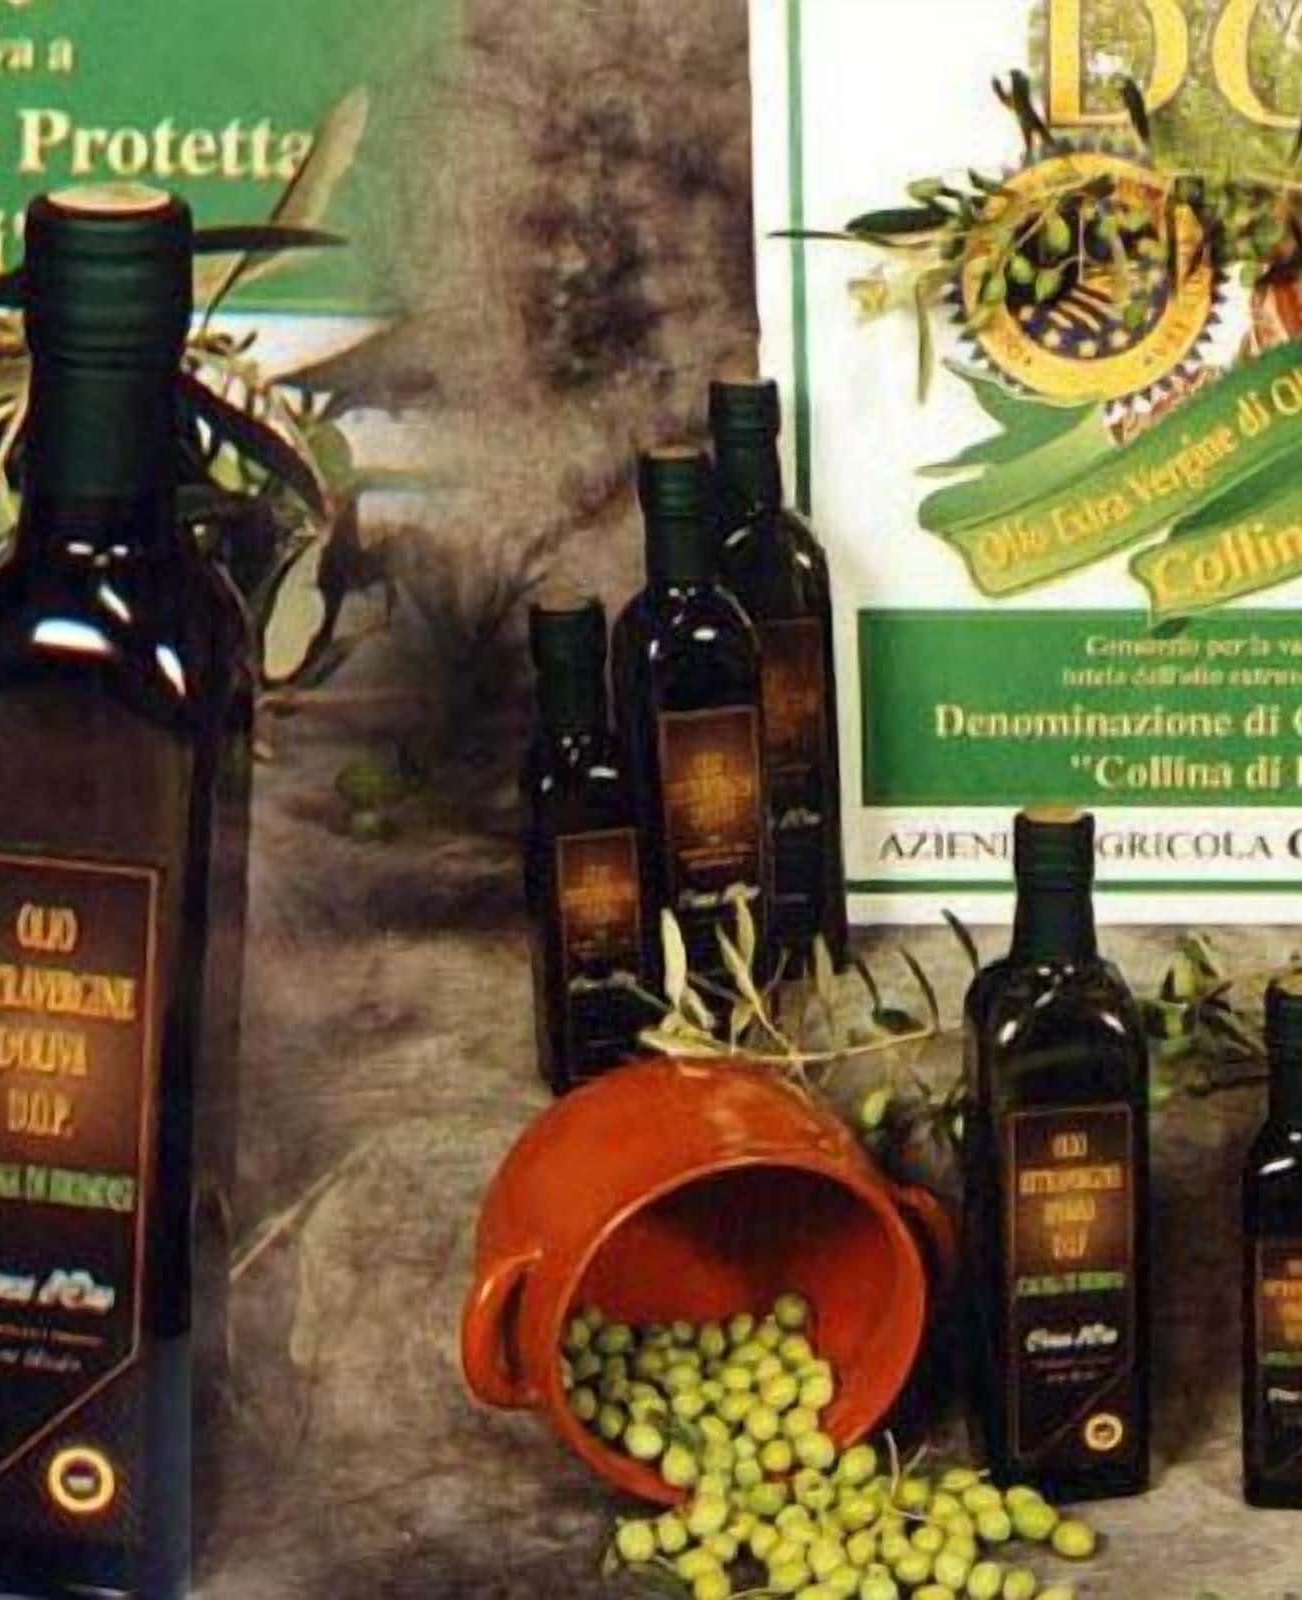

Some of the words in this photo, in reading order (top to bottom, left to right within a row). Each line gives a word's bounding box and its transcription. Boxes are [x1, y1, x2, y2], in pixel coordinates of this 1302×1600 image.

[48, 36, 75, 73] a
[16, 107, 314, 180] Protetta
[1051, 489, 1135, 547] Extra
[1130, 422, 1239, 502] Vergine
[1237, 390, 1272, 437] di
[935, 703, 1233, 741] Denominazione
[1244, 703, 1280, 737] di
[1070, 754, 1234, 789] "Collina
[1245, 755, 1281, 788] di
[1095, 829, 1274, 860] GRICOLA
[16, 902, 78, 954] OLIO
